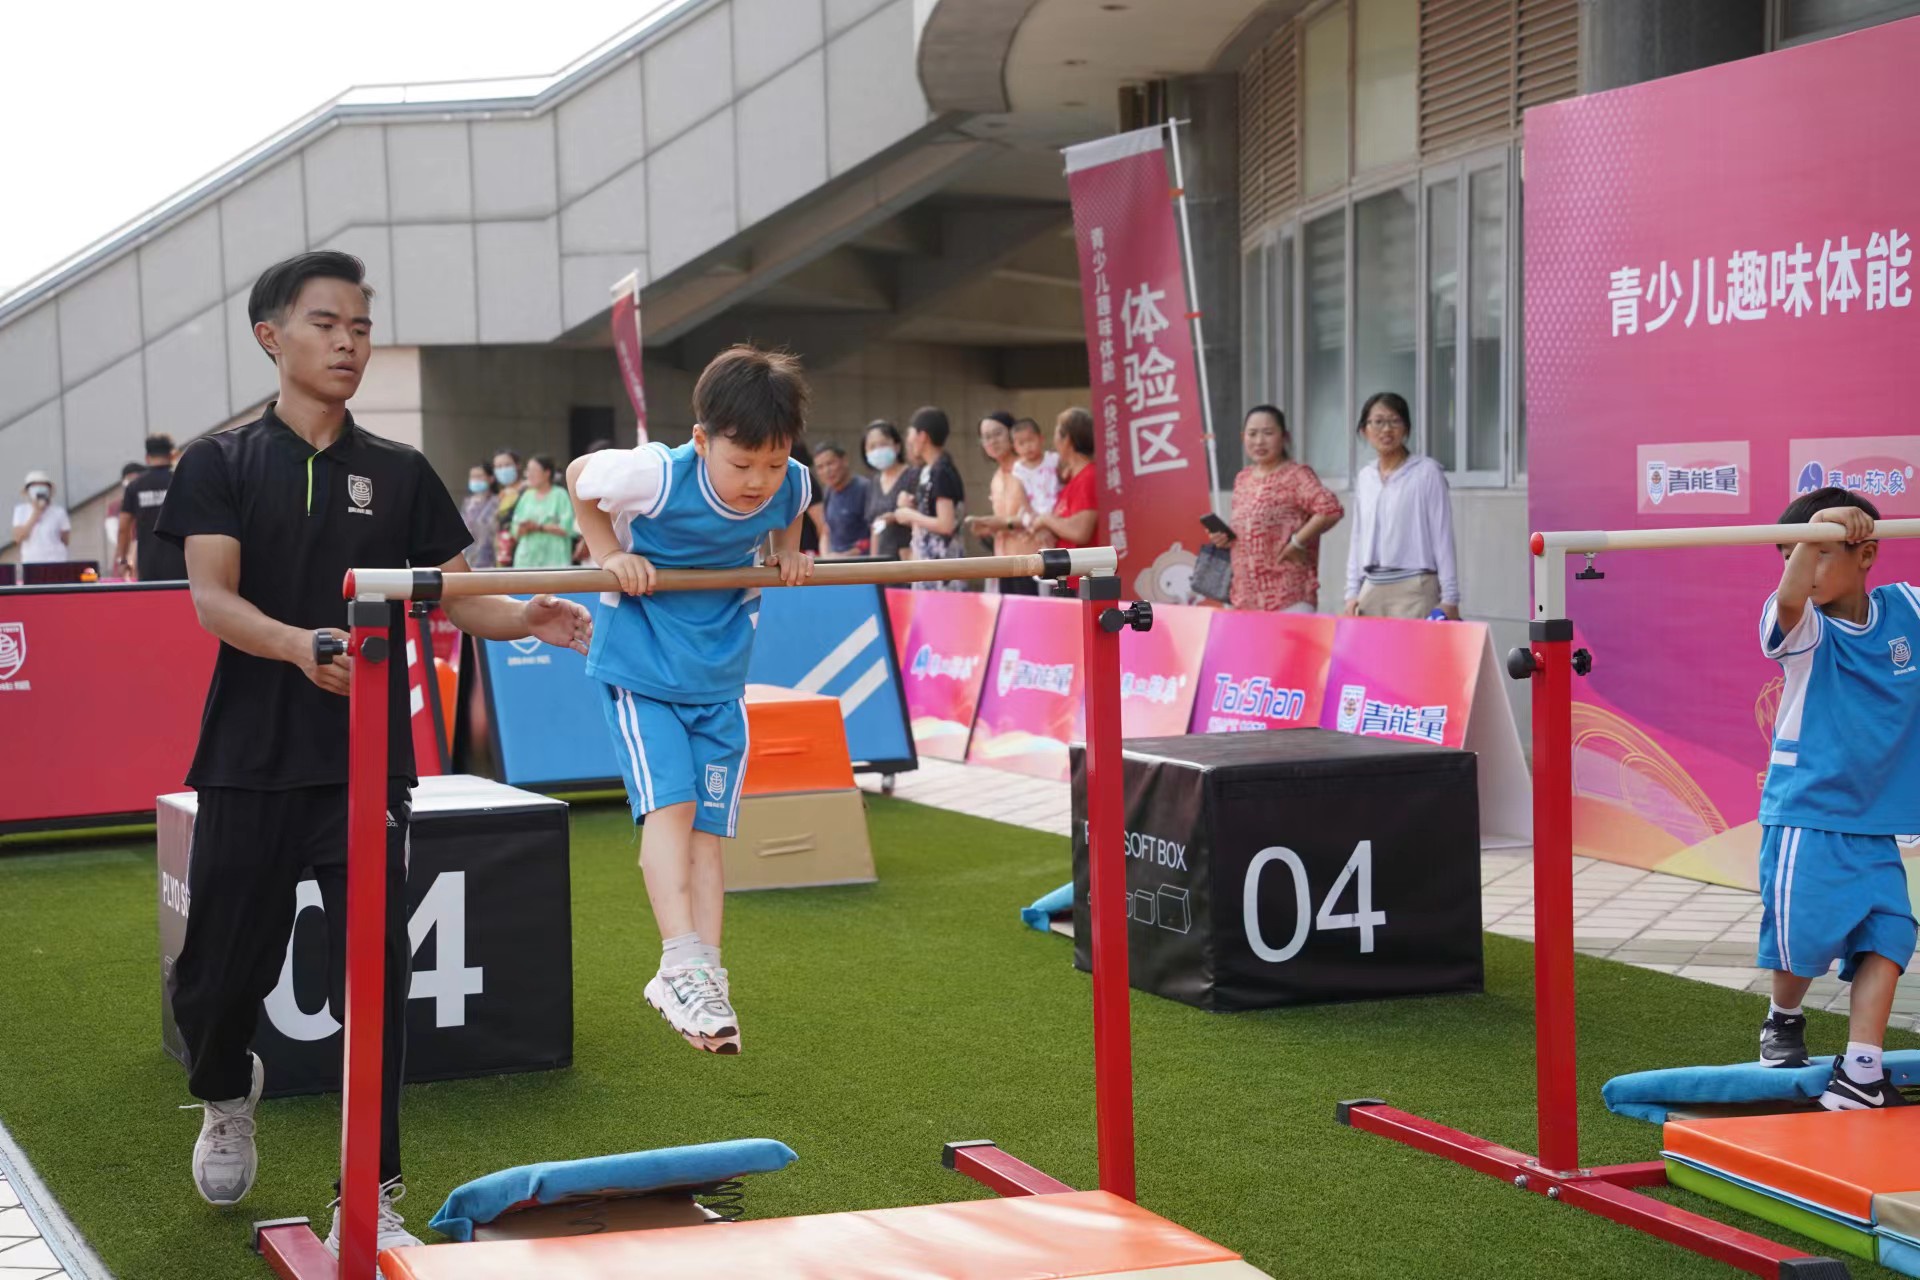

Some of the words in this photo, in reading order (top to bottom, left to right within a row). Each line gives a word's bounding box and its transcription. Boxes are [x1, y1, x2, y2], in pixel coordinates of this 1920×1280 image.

[1608, 229, 1912, 337] 青少儿趣味体能
[1120, 282, 1188, 476] 体验区
[1667, 464, 1738, 496] 青能量
[1212, 673, 1305, 720] TaiShan
[1359, 699, 1448, 744] 青能量
[1124, 830, 1156, 862] SOFT
[1158, 839, 1188, 871] BOX
[163, 871, 180, 912] PLYO
[1243, 839, 1386, 963] 04
